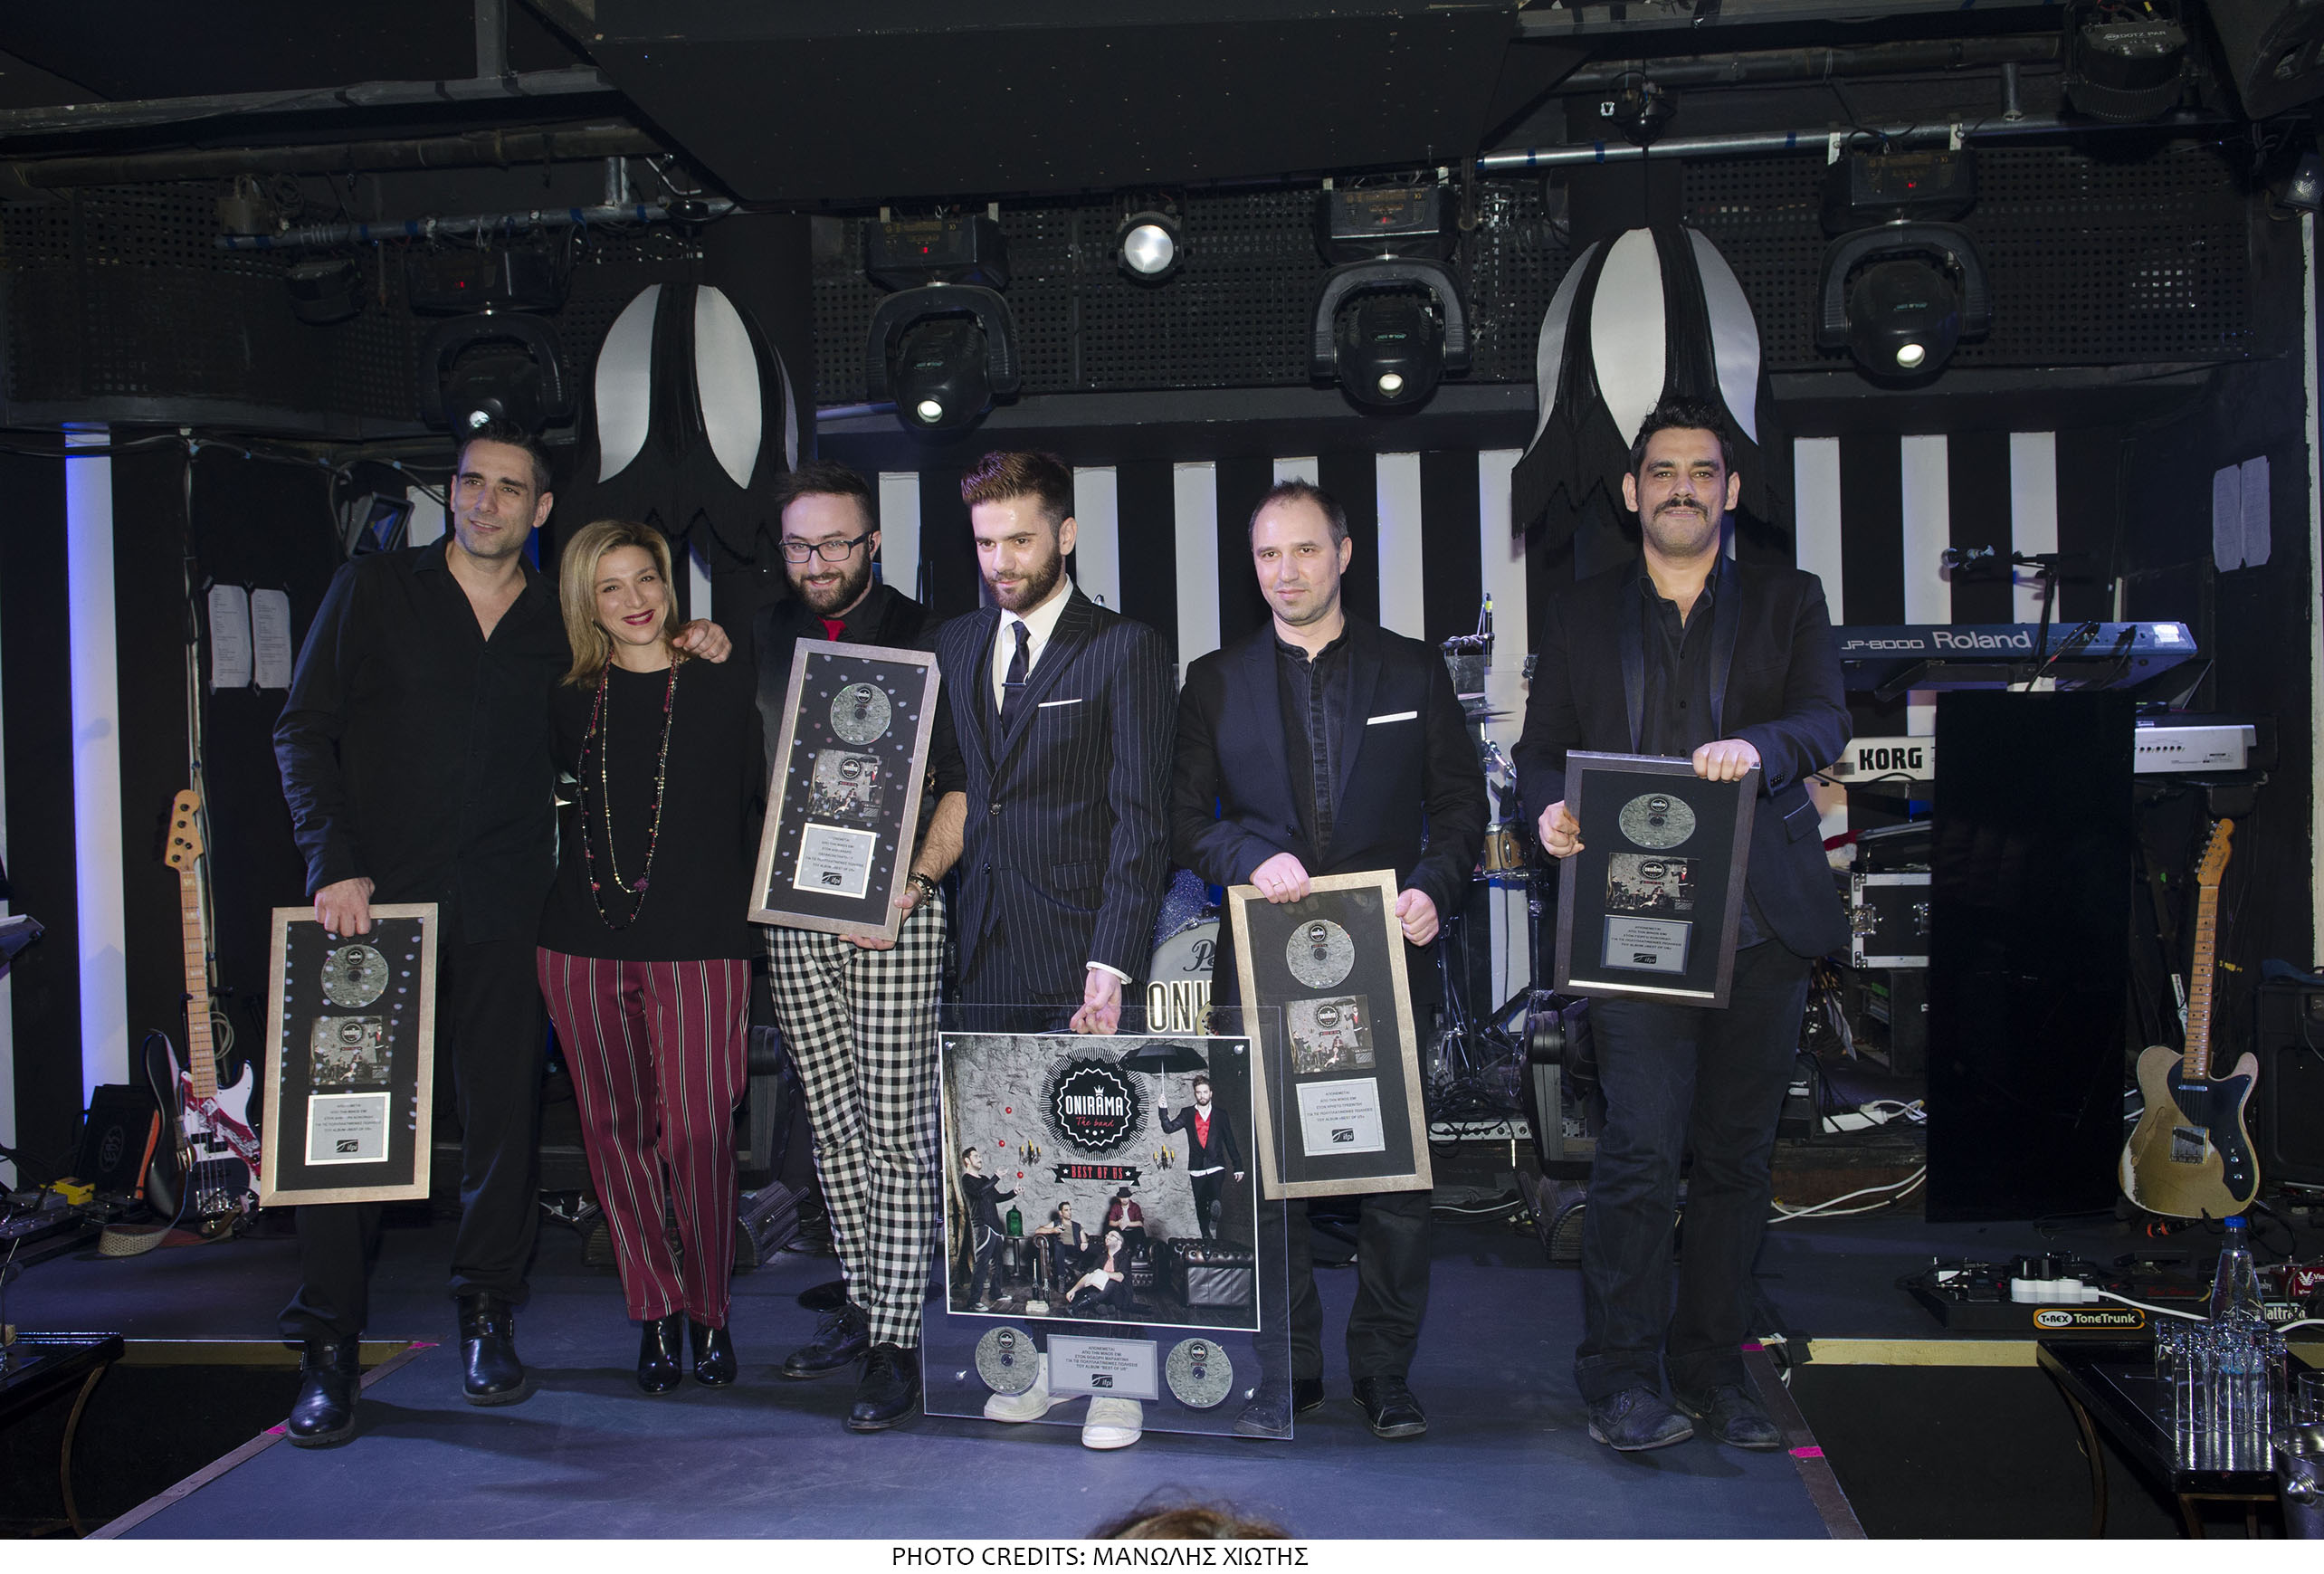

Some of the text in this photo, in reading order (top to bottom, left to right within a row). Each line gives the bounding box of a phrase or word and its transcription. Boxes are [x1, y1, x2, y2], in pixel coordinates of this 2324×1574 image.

[1841, 631, 2032, 650] JP-8000 Roland
[1859, 747, 1923, 770] KORG
[1147, 980, 1213, 1033] ONI
[1065, 1095, 1124, 1116] ONIRAMA
[1076, 1116, 1115, 1128] The band
[1072, 1165, 1123, 1180] BEST OF US
[2073, 1313, 2136, 1323] ToneTrunk
